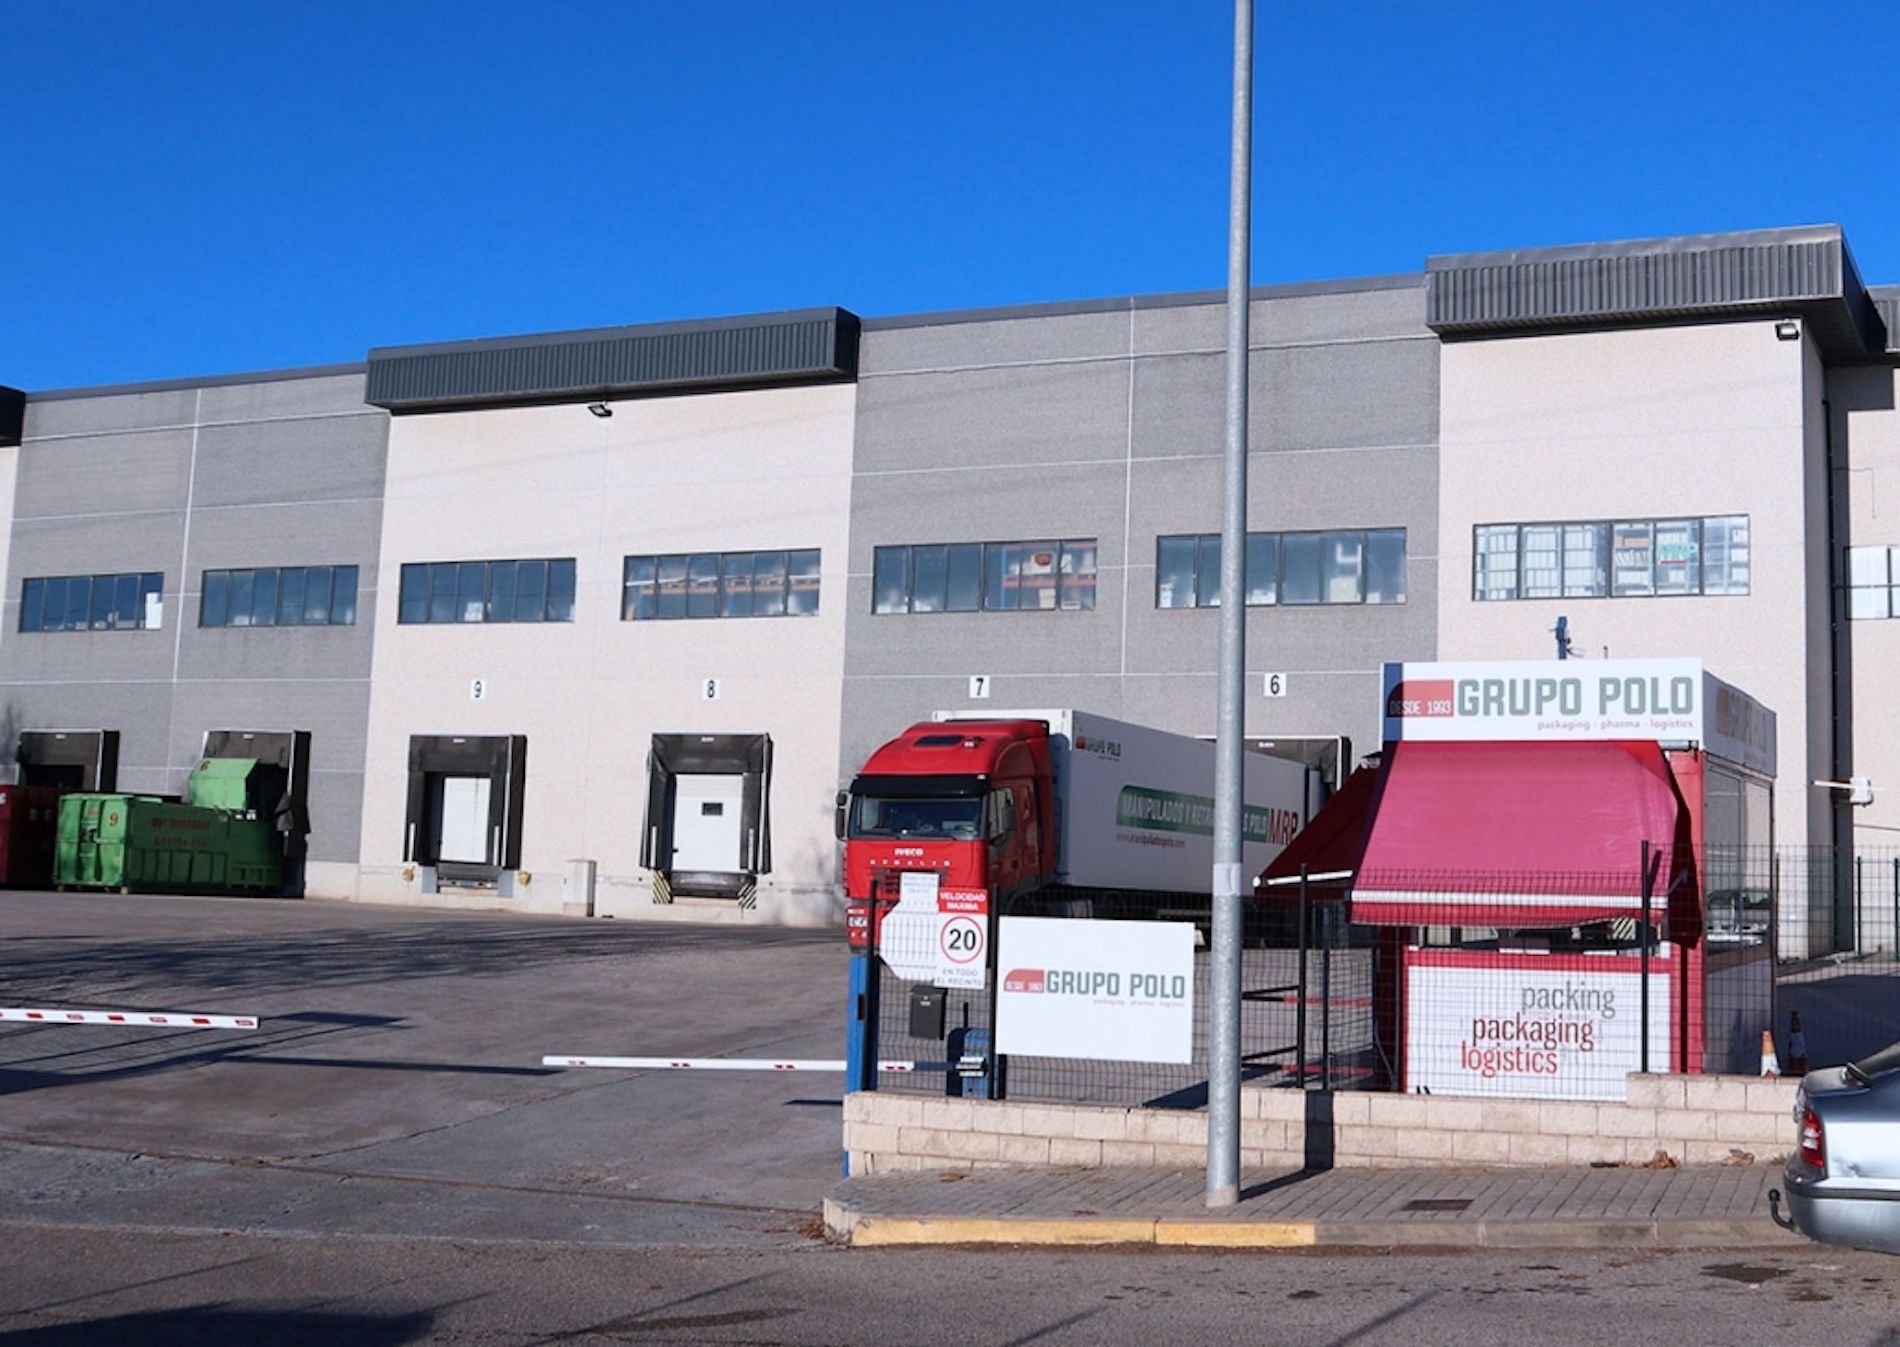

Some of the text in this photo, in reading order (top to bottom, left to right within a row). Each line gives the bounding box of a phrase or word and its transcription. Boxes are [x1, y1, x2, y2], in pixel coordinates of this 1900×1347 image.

[474, 680, 482, 698] 9
[707, 679, 716, 698] 8
[975, 677, 985, 696] 7
[1270, 674, 1280, 695] 6
[1457, 676, 1694, 717] GRUPO POLO
[1427, 701, 1453, 715] 1993
[1537, 718, 1694, 731] packaging pharma logistics
[1269, 808, 1299, 846] MRP
[894, 848, 924, 857] IVECO
[940, 891, 987, 901] VELOCIDAD
[948, 928, 977, 952] 20
[942, 968, 978, 977] EN TODO
[1046, 969, 1186, 999] GRUPO POLO
[1521, 980, 1616, 1019] packing
[1472, 1011, 1595, 1052] packaging
[1461, 1039, 1558, 1078] logistics
